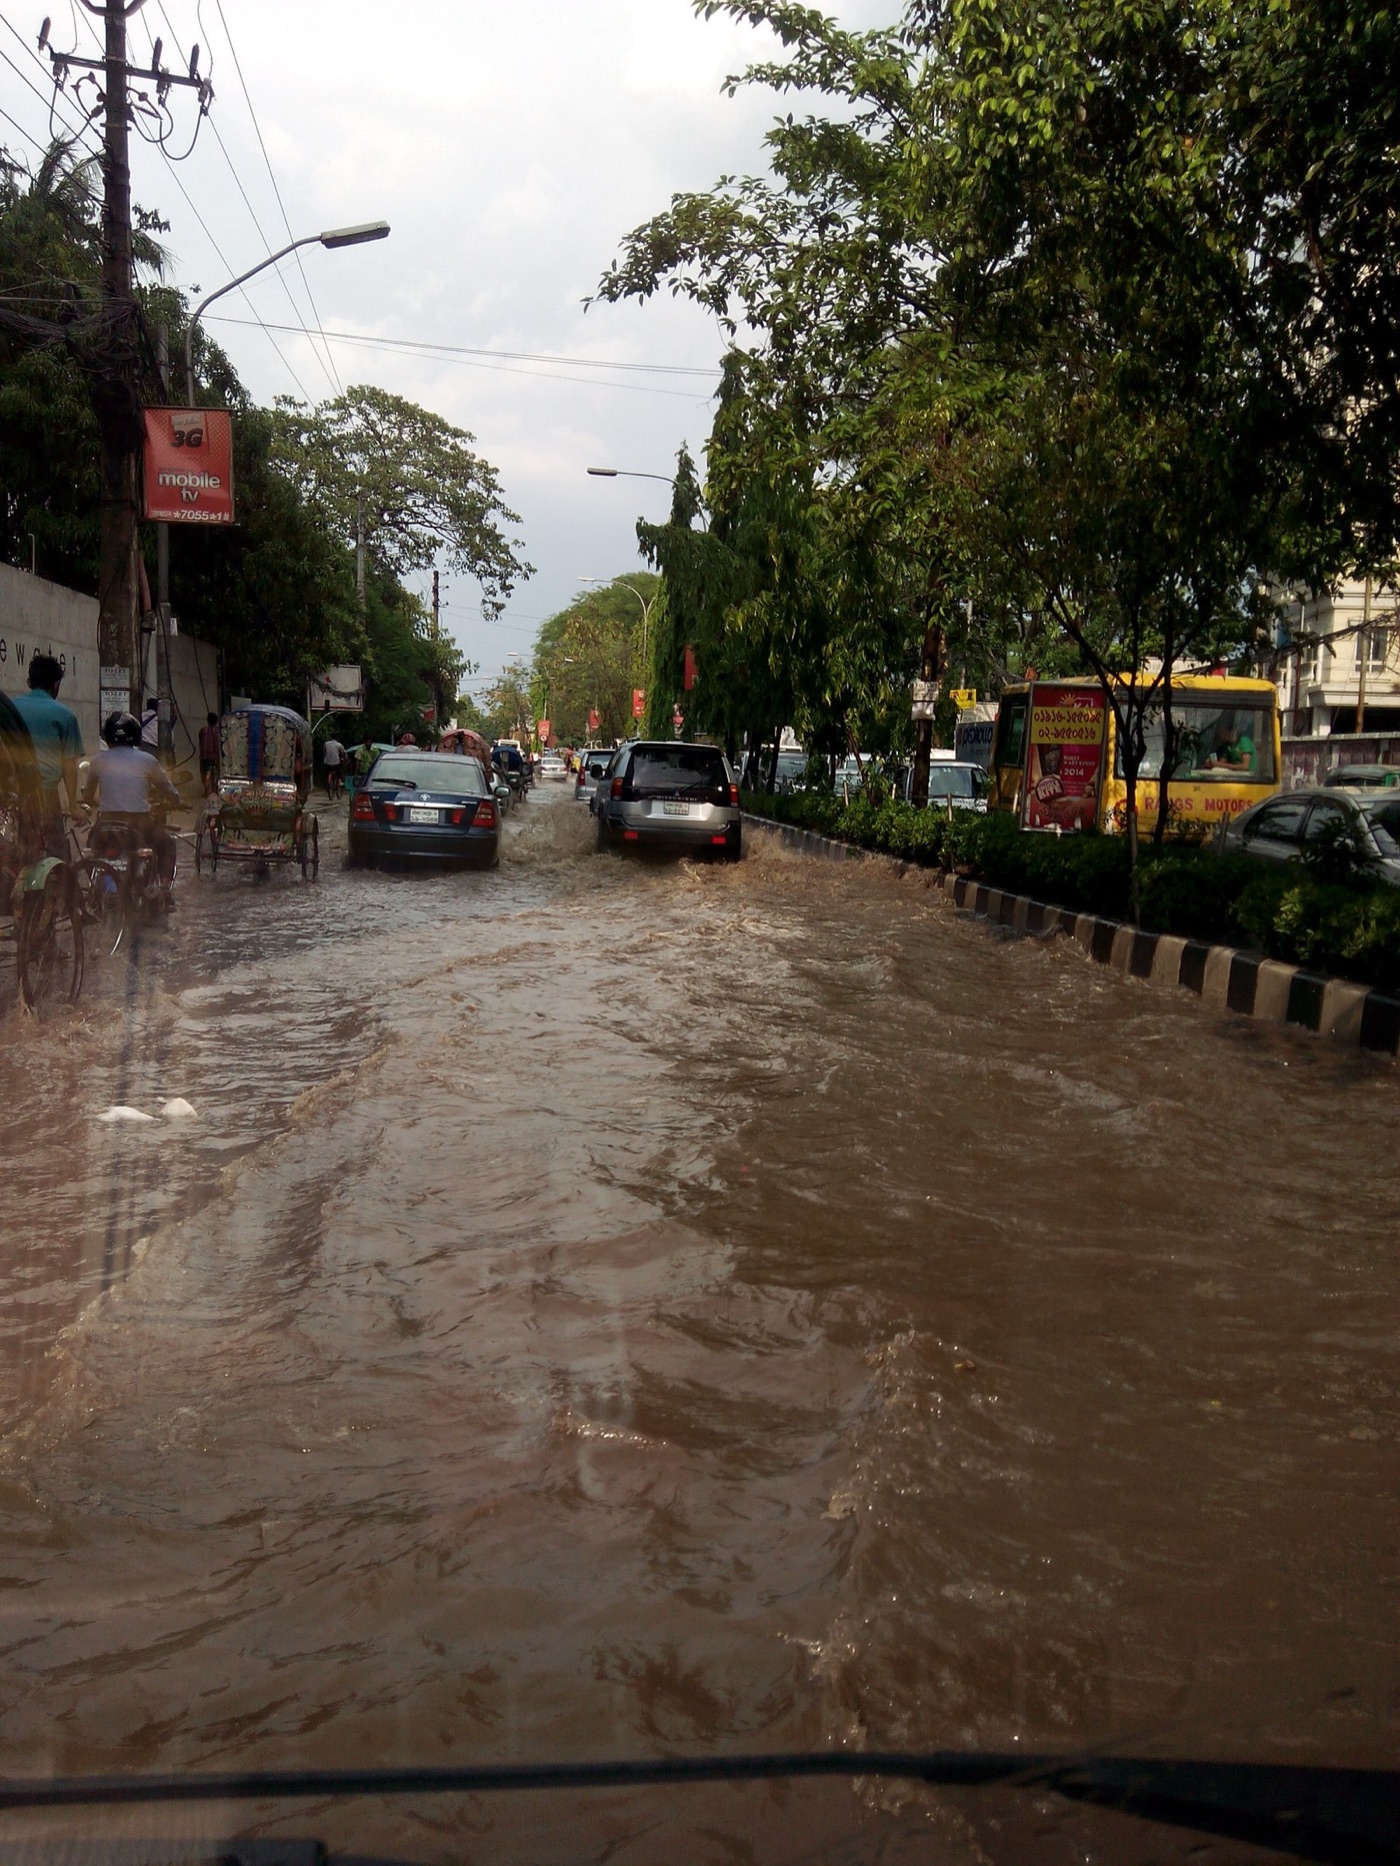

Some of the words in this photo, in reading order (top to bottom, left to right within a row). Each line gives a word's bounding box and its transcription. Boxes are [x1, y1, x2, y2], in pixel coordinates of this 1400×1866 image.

[171, 428, 203, 448] 3G
[158, 470, 221, 489] mobile
[181, 487, 199, 502] tv
[1063, 768, 1085, 776] 2014
[1205, 798, 1254, 812] MOTORS
